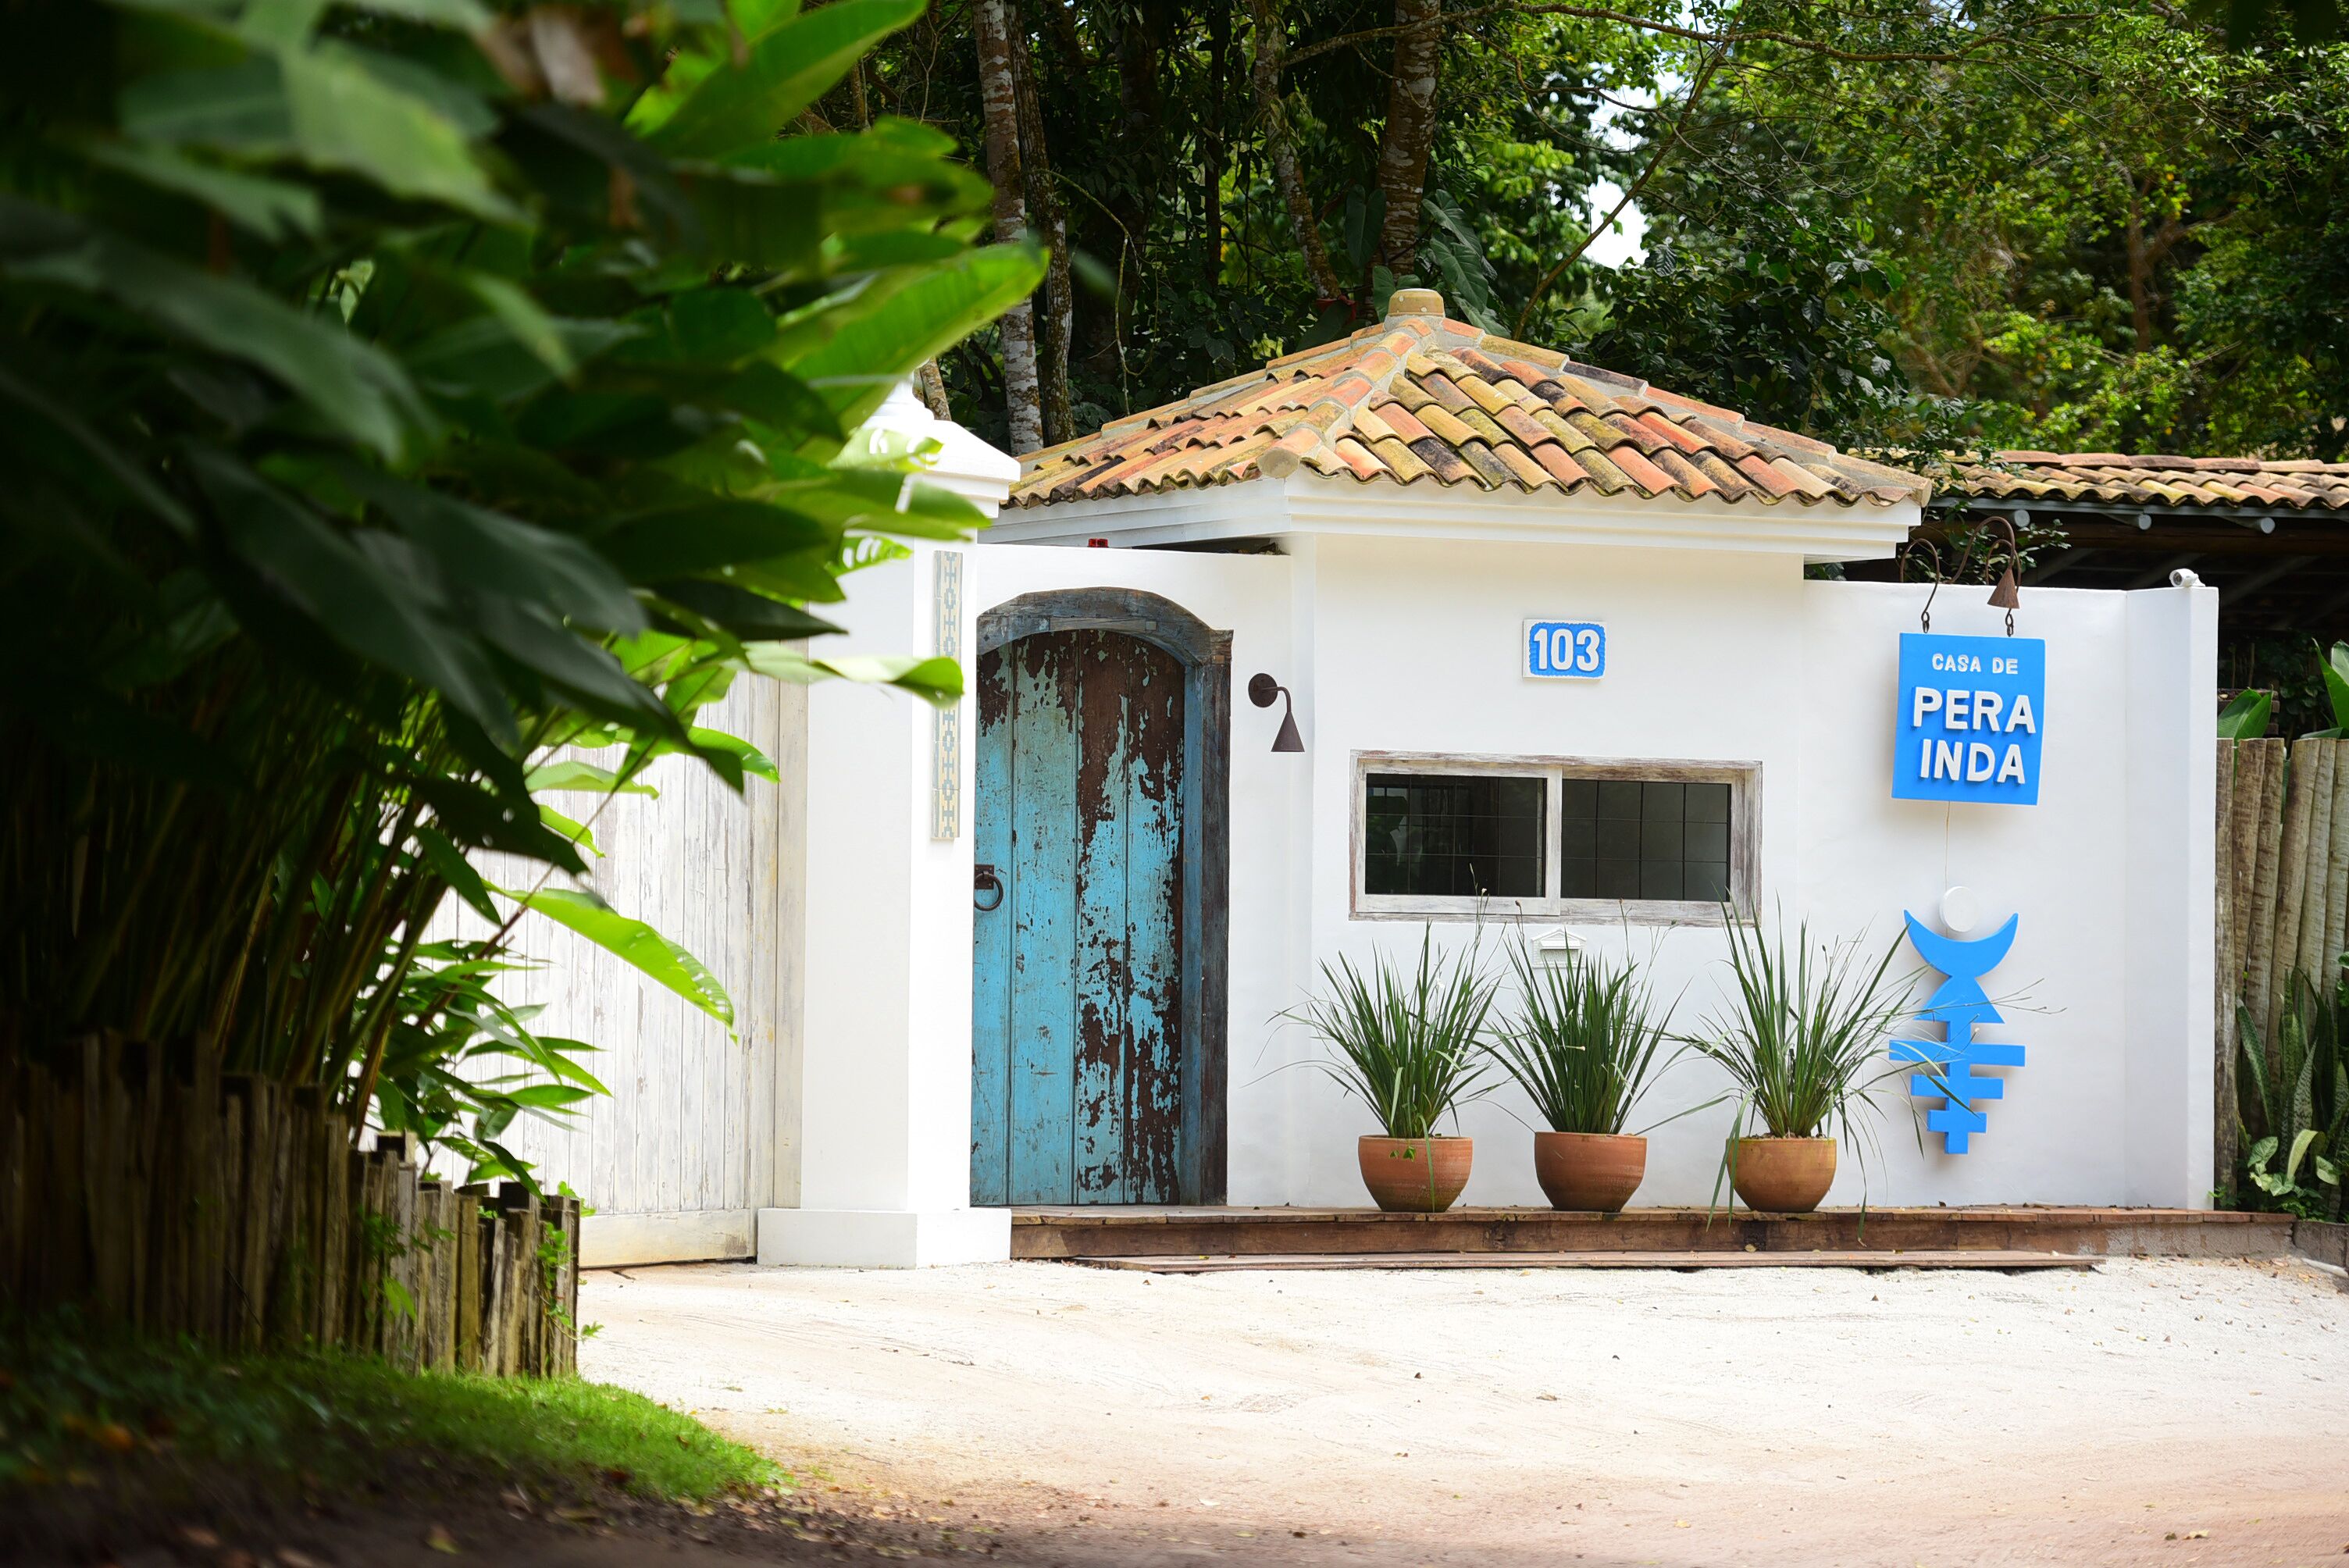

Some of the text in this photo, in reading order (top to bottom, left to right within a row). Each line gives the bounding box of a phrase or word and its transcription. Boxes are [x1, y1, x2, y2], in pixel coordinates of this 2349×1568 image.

[1534, 628, 1600, 672] 103
[1931, 653, 2019, 675] CASA DE
[1912, 686, 2037, 734] PERA
[1919, 739, 2026, 785] INDA
